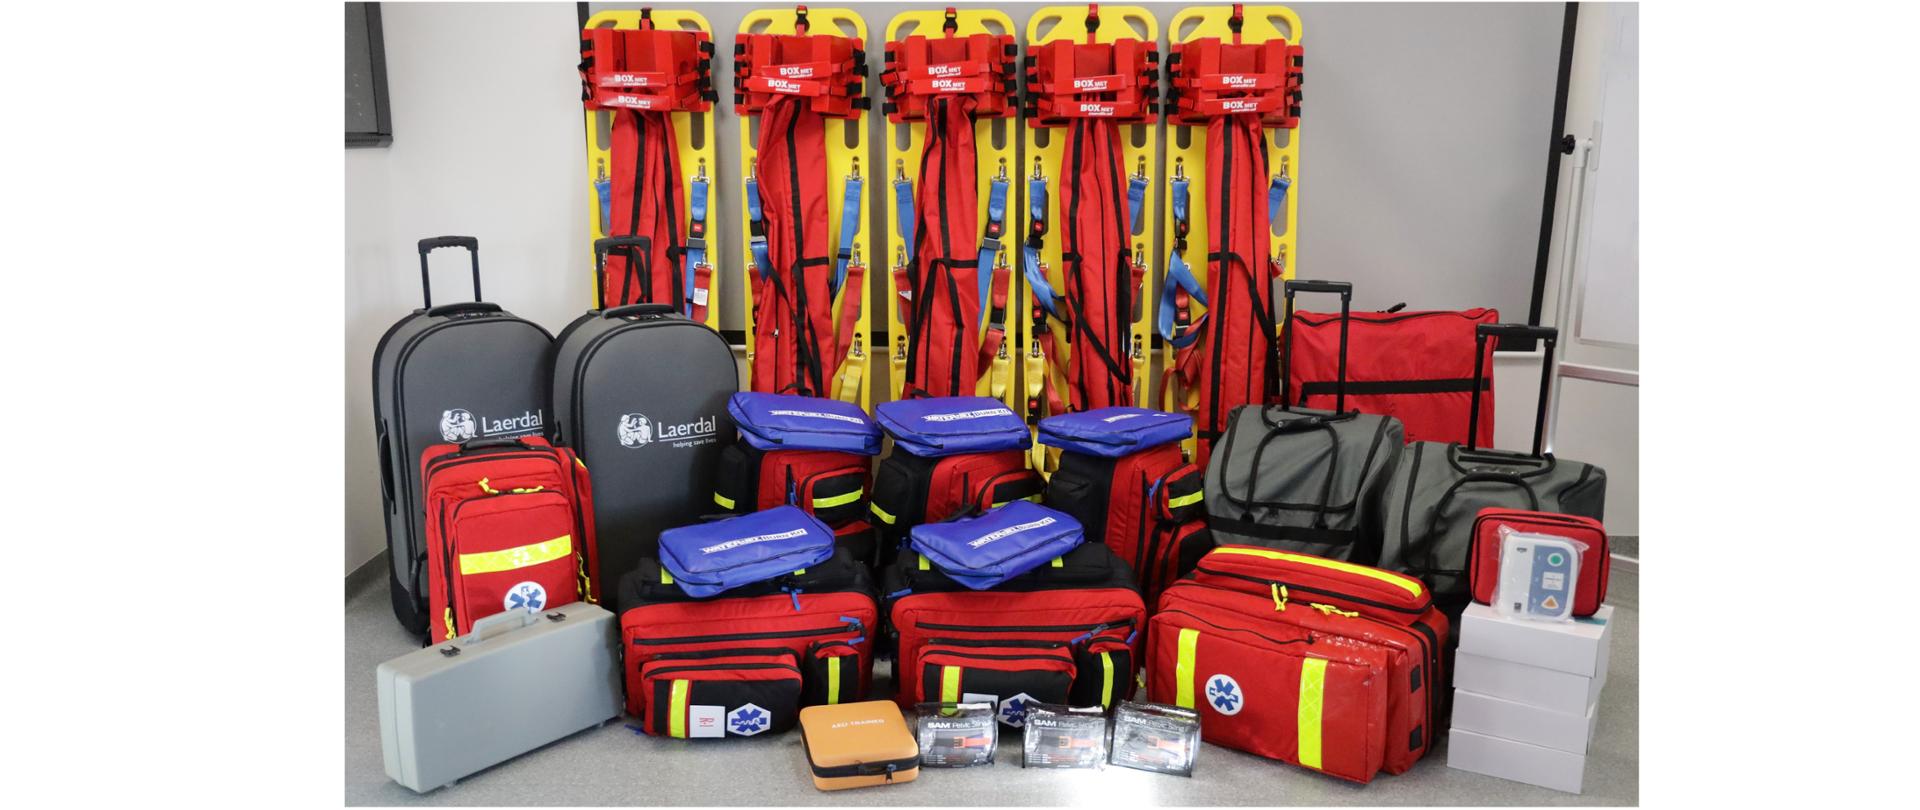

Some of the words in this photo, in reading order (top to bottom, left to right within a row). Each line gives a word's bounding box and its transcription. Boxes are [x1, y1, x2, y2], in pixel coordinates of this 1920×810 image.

[780, 66, 800, 75] BOX
[928, 65, 948, 75] BOX
[614, 74, 634, 82] BOX
[1223, 75, 1243, 85] BOX
[768, 79, 788, 88] BOX
[932, 80, 952, 88] BOX
[1074, 79, 1094, 88] BOX
[618, 95, 638, 104] BOX
[1080, 104, 1101, 112] BOX
[1223, 100, 1244, 110] BOX
[482, 409, 543, 433] Laerdal
[658, 415, 716, 438] Laerdal
[1034, 719, 1056, 727] SAM
[1123, 715, 1146, 724] SAM
[927, 721, 950, 729] SAM
